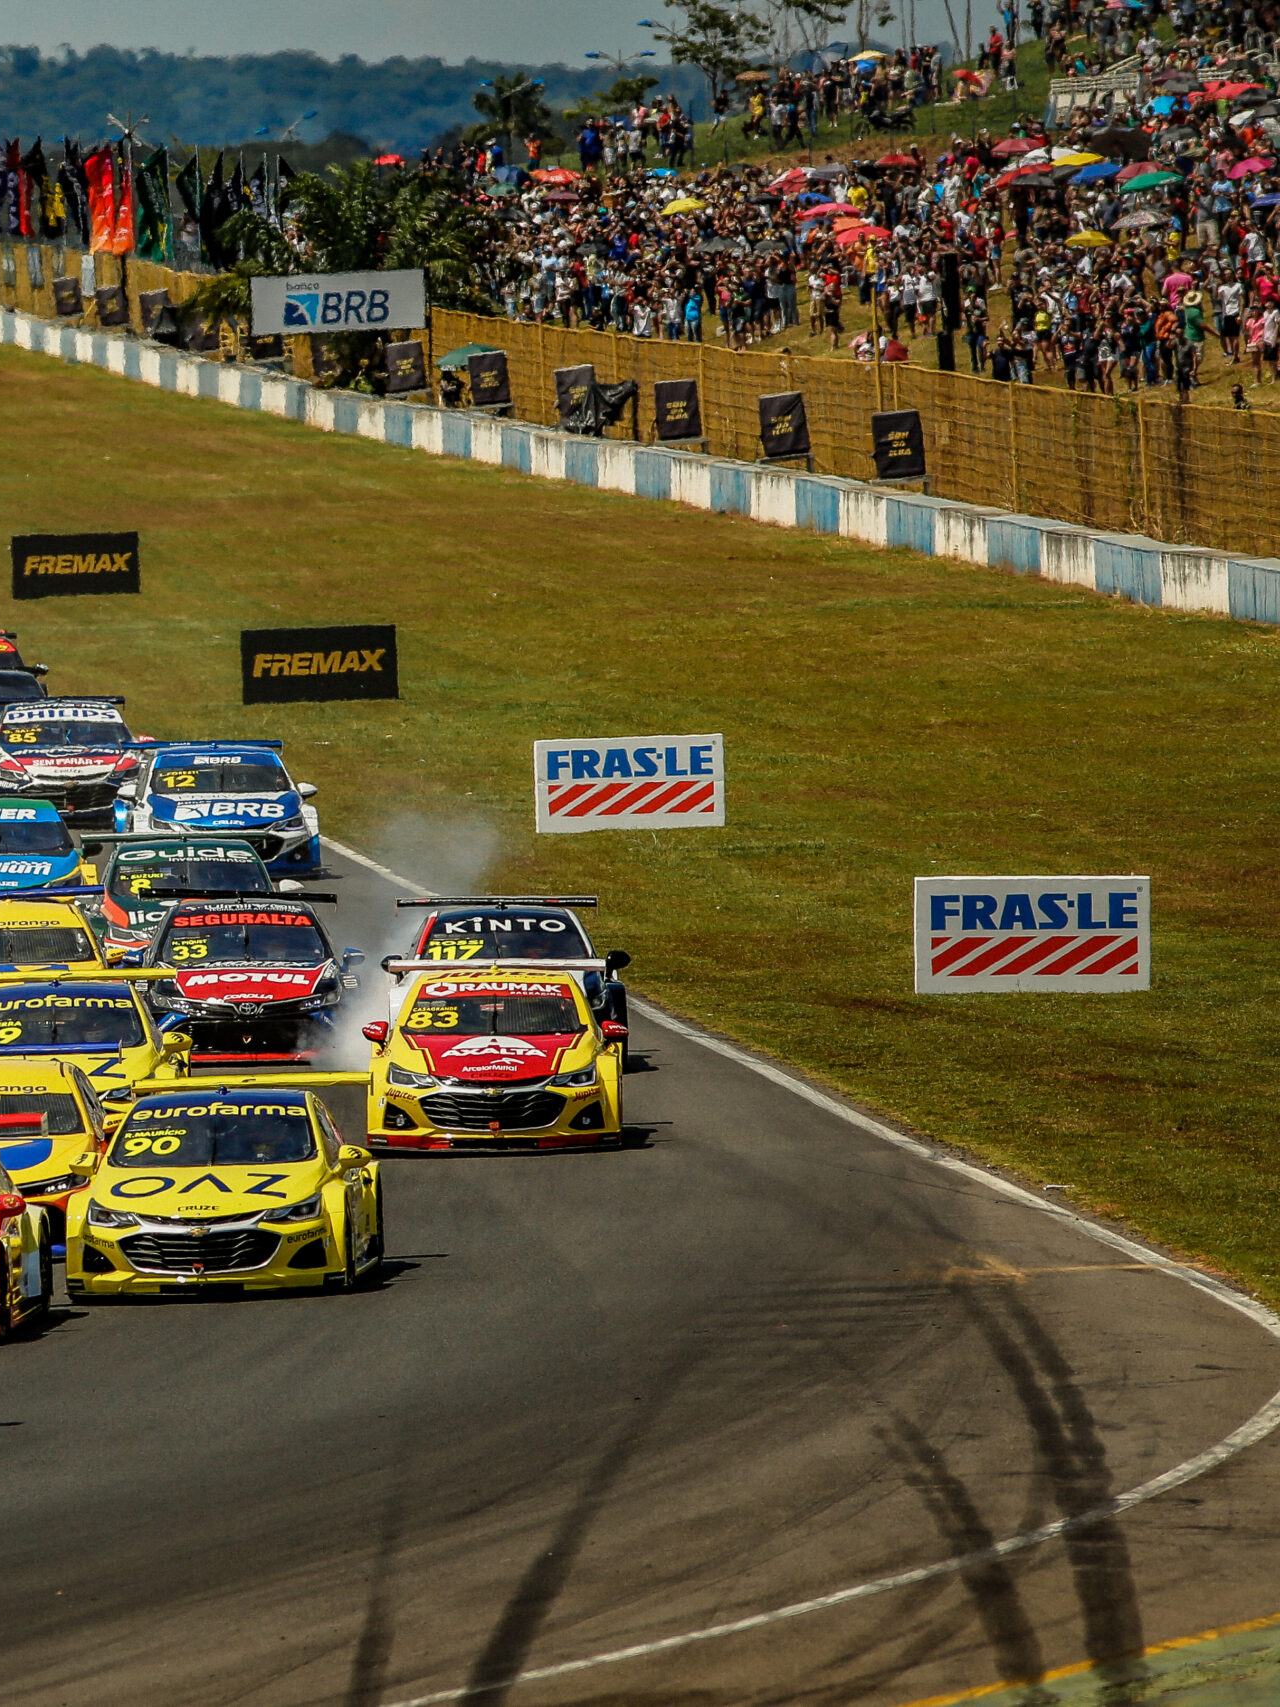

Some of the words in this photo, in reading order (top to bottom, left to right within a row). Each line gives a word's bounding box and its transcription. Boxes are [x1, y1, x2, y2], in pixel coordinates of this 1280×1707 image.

[322, 289, 389, 324] BRB
[23, 551, 132, 576] FREMAX
[252, 648, 387, 678] FREMAX
[8, 709, 116, 720] PHILIPS
[8, 732, 38, 743] 85
[210, 756, 242, 764] BRB
[162, 775, 196, 788] 12
[212, 802, 285, 818] BRB
[118, 846, 253, 861] Guide
[129, 878, 151, 894] 8
[173, 913, 313, 927] SEGURALTA
[172, 944, 208, 960] 33
[426, 944, 484, 960] 117
[185, 973, 310, 987] MOTUL
[458, 982, 562, 992] RAUMAK
[406, 1011, 459, 1029] 83
[440, 1046, 548, 1058] AXALTA
[131, 1101, 307, 1121] eurofarma
[123, 1136, 182, 1158] 90
[177, 1204, 221, 1212] CRUZE
